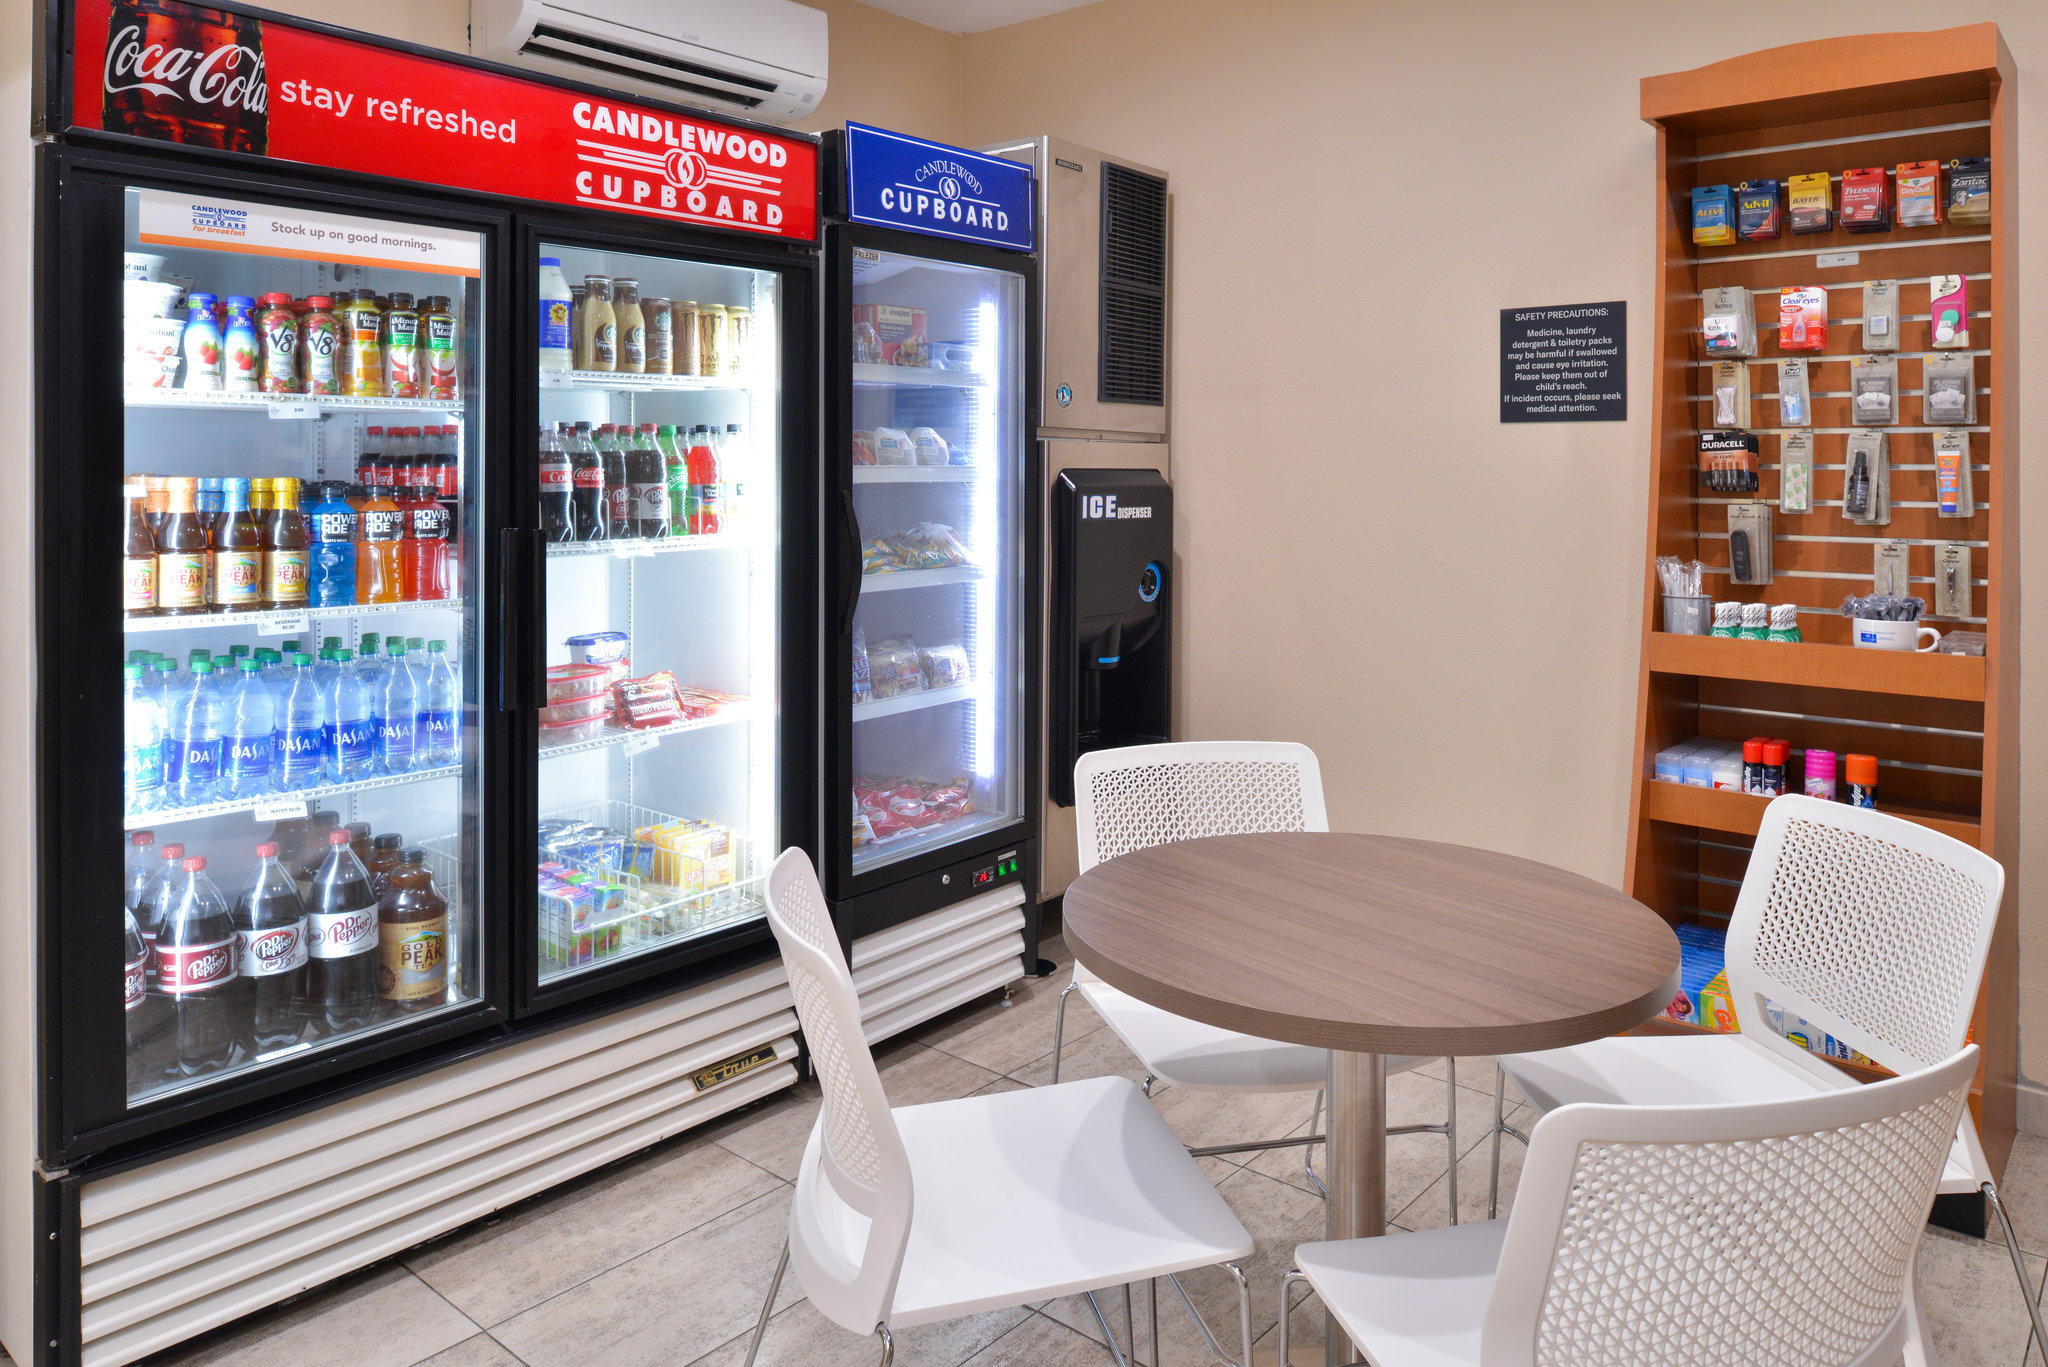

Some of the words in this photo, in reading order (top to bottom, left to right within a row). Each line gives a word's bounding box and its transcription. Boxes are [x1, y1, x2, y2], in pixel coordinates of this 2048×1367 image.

[104, 25, 268, 114] Coca-Cola
[281, 79, 354, 117] stay
[366, 97, 516, 144] refreshed
[573, 102, 787, 168] CANDLEWOOD
[915, 160, 982, 195] CANDLEWOOD
[1952, 178, 1988, 187] Zantac
[1845, 186, 1877, 195] TYLENOL
[1901, 185, 1930, 196] DayQuil
[576, 171, 783, 226] CUPBOARD
[1741, 199, 1769, 210] Advil
[192, 205, 247, 217] CANDLEWOOD
[881, 187, 1008, 231] CUPBOARD
[1696, 207, 1724, 218] ALEVE
[192, 218, 246, 229] CUPBOARD
[207, 227, 245, 237] breakfast
[271, 221, 305, 236] Stock
[310, 229, 325, 240] up
[329, 231, 344, 241] on
[347, 230, 378, 244] good
[381, 236, 436, 252] mornings.
[854, 249, 880, 262] FREEZER
[1515, 311, 1545, 321] SAFETY
[1547, 308, 1609, 319] PRECAUTIONS:
[1527, 329, 1565, 337] Medicine,
[1566, 326, 1596, 336] laundry
[270, 326, 294, 353] V8
[308, 328, 333, 355] V8
[1512, 340, 1549, 349] detergent
[1550, 339, 1556, 347] &
[1558, 338, 1586, 347] toiletry
[1588, 337, 1612, 346] packs
[1507, 353, 1523, 361] may
[1525, 351, 1534, 359] be
[1536, 349, 1566, 358] harmful
[1568, 348, 1574, 357] if
[1576, 347, 1617, 357] swallowed
[1515, 362, 1530, 370] and
[1532, 362, 1554, 370] cause
[1556, 362, 1570, 370] eye
[1571, 359, 1608, 368] irritation.
[1514, 372, 1540, 381] Please
[1541, 371, 1560, 381] keep
[1562, 371, 1583, 379] them
[1584, 371, 1598, 379] out
[1599, 370, 1608, 378] of
[1535, 383, 1561, 391] child's
[1563, 382, 1587, 390] reach.
[1504, 394, 1511, 402] If
[1511, 393, 1542, 402] incident
[1544, 394, 1573, 402] occurs,
[1574, 392, 1601, 402] please
[1602, 391, 1622, 400] seek
[1526, 404, 1557, 413] medical
[1558, 404, 1597, 412] attention.
[1701, 440, 1744, 449] DURACELL
[1082, 495, 1117, 519] ICE
[1117, 506, 1152, 519] DISPENSER
[321, 523, 348, 534] ADE
[365, 521, 391, 532] ADE
[413, 519, 438, 529] ADE
[345, 916, 361, 928] Dr
[333, 919, 371, 944] Pepper
[270, 933, 286, 947] Dr
[401, 937, 442, 952] GOLD
[255, 935, 293, 958] Pepper
[202, 954, 217, 966] Dr
[401, 946, 442, 965] PEAK
[191, 956, 225, 980] Pepper
[264, 958, 281, 970] Diet
[413, 961, 434, 970] TEA
[723, 1055, 759, 1079] true
